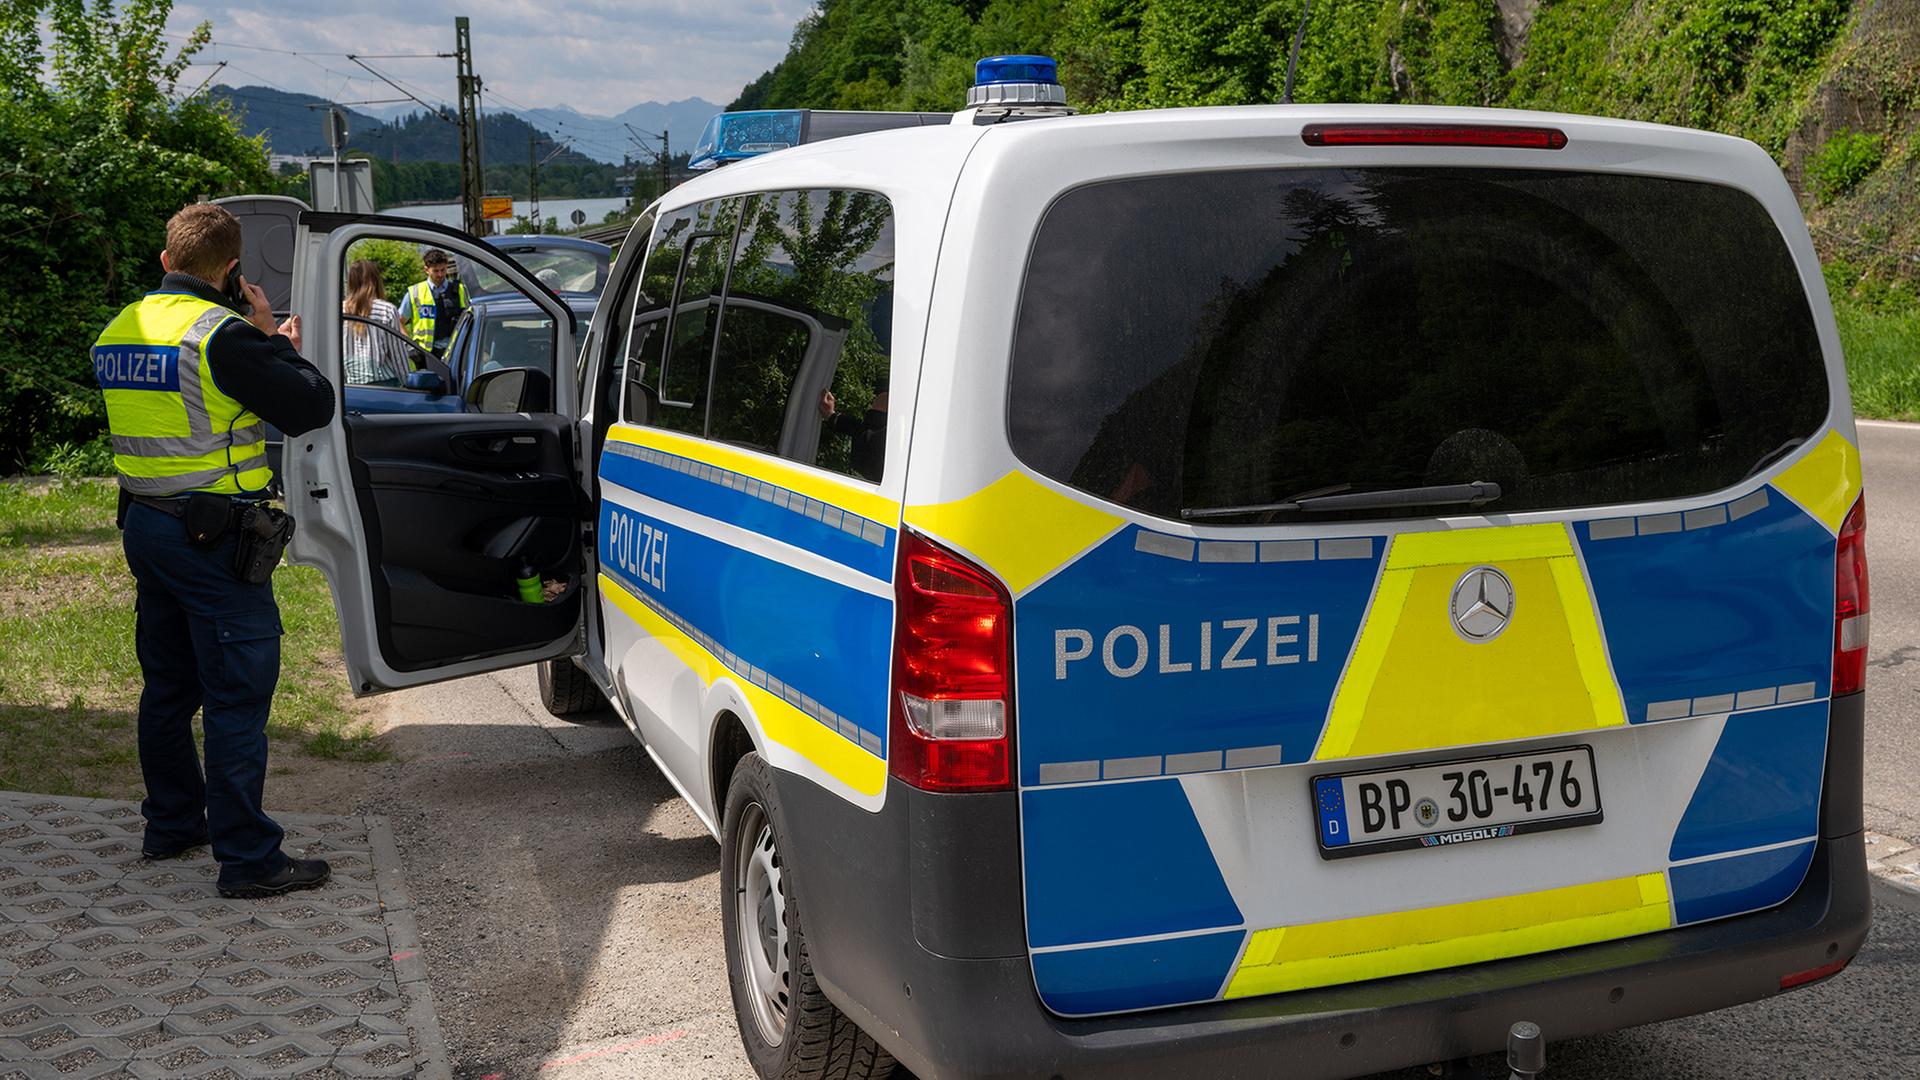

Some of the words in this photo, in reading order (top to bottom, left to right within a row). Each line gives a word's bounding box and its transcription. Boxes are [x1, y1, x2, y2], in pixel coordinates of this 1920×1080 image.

[96, 352, 167, 384] POLIZEI
[609, 510, 668, 593] POLIZEI
[1054, 613, 1319, 680] POLIZEI
[1358, 778, 1412, 834] BP
[1442, 759, 1582, 823] 30-476
[1329, 820, 1340, 835] D
[1439, 828, 1499, 845] MOSOLF
